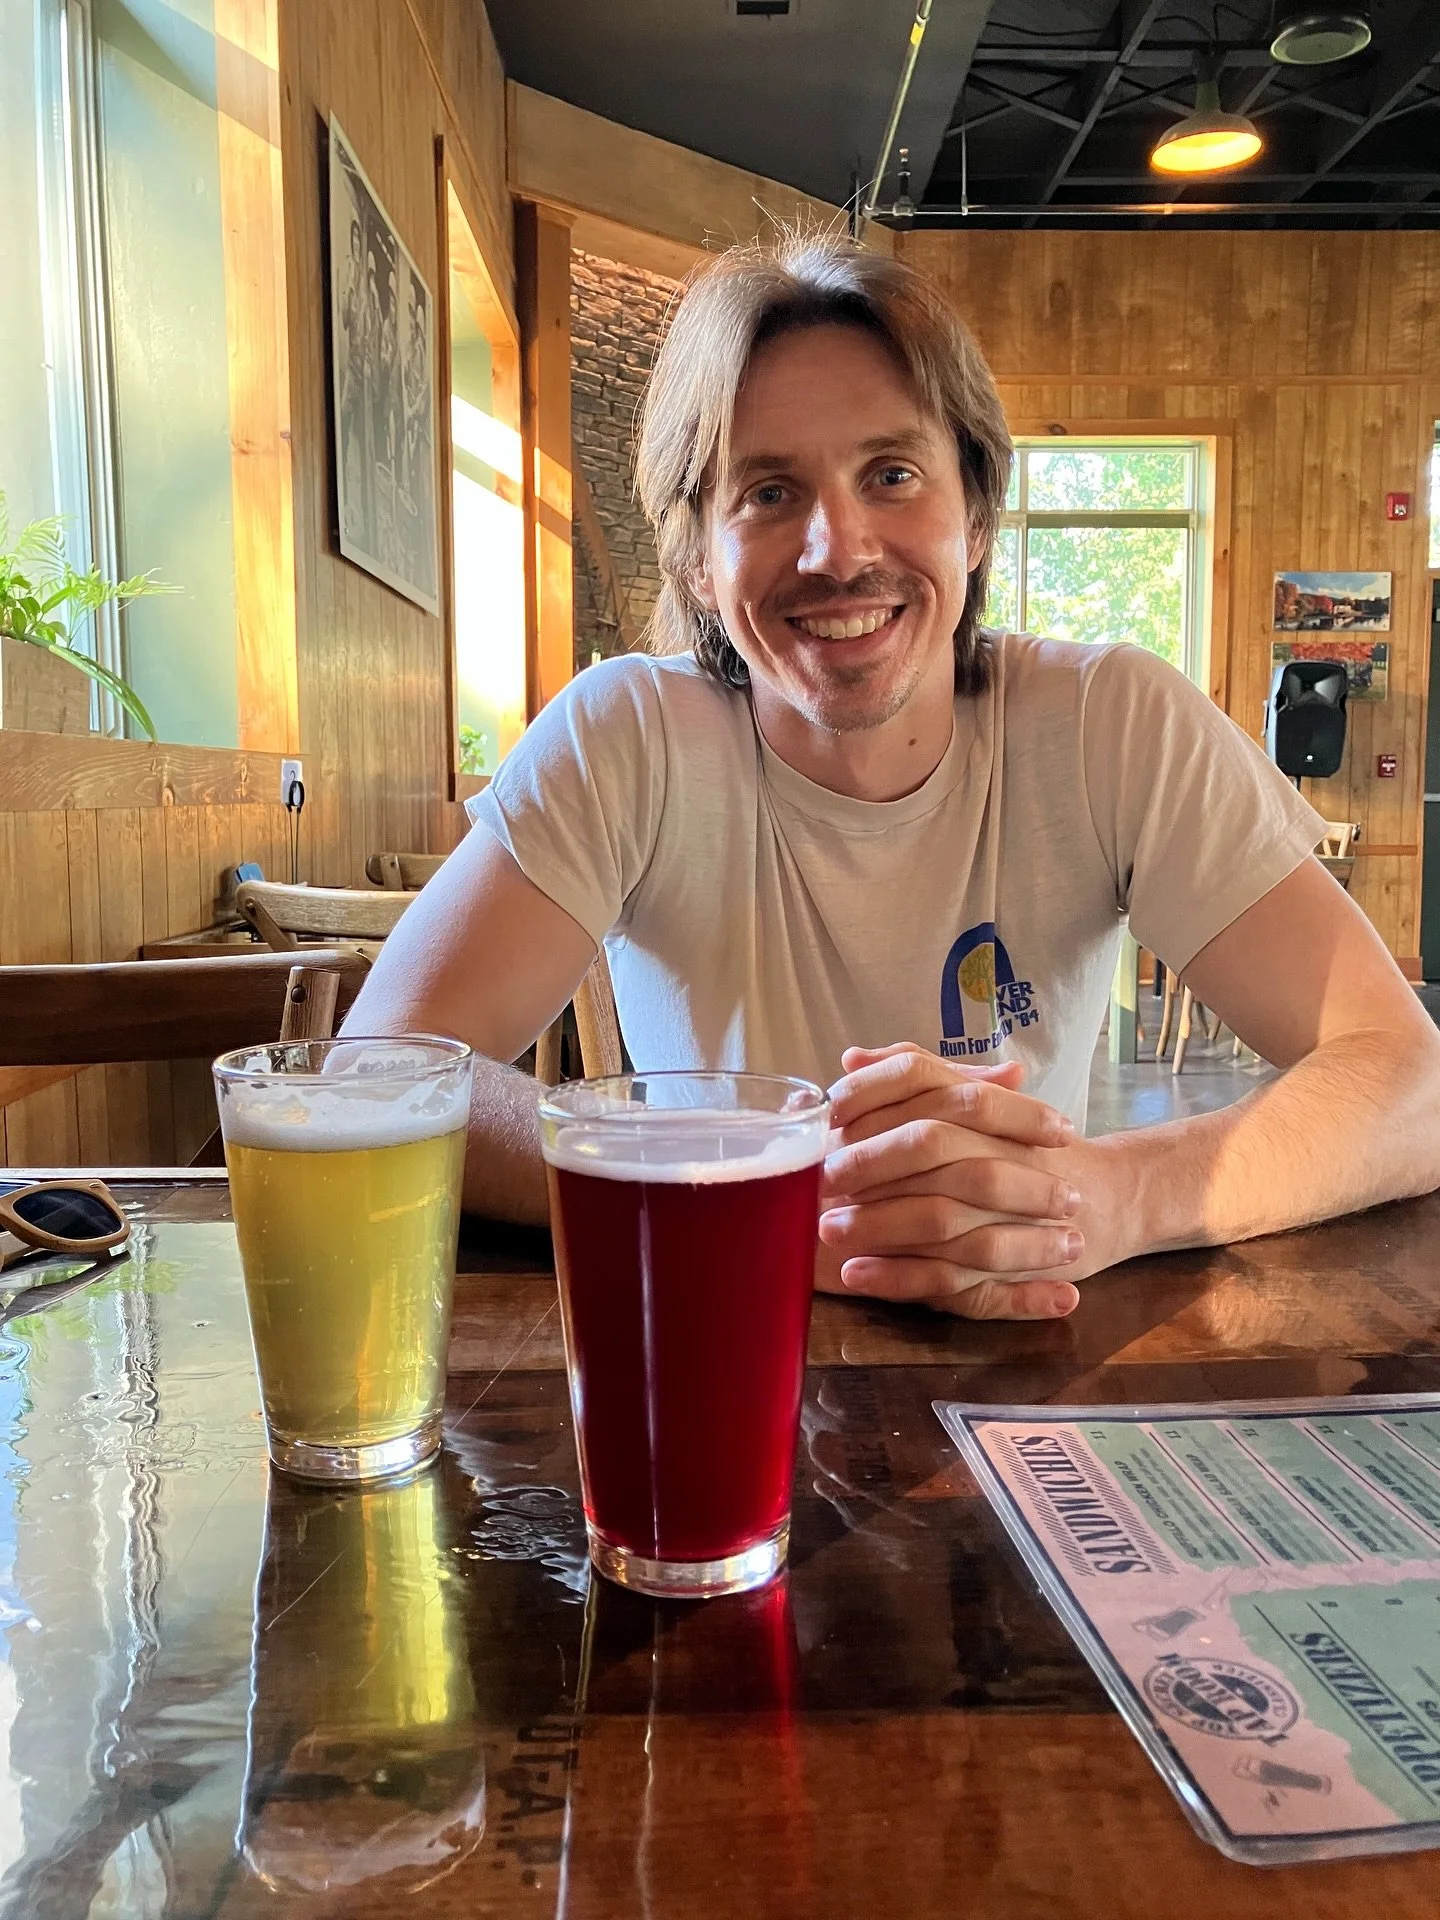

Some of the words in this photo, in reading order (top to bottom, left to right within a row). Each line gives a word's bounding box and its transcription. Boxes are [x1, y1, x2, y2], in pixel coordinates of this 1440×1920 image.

[995, 981, 1035, 1001] VER
[997, 996, 1031, 1018] ND
[940, 1040, 966, 1057] Run
[967, 1038, 991, 1054] For
[1087, 1430, 1108, 1439] 11
[1161, 1429, 1182, 1438] 11
[1111, 1460, 1141, 1481] WRAP
[1182, 1453, 1212, 1472] WRAP
[1201, 1473, 1235, 1496] SALAD
[1010, 1434, 1151, 1576] SANDWICHES
[1129, 1483, 1171, 1518] CHICKEN
[1159, 1519, 1205, 1558] BUFFALO
[1156, 1652, 1237, 1704] ROOM
[1289, 1632, 1440, 1796] PPETIZERS
[1228, 1709, 1290, 1748] TAP
